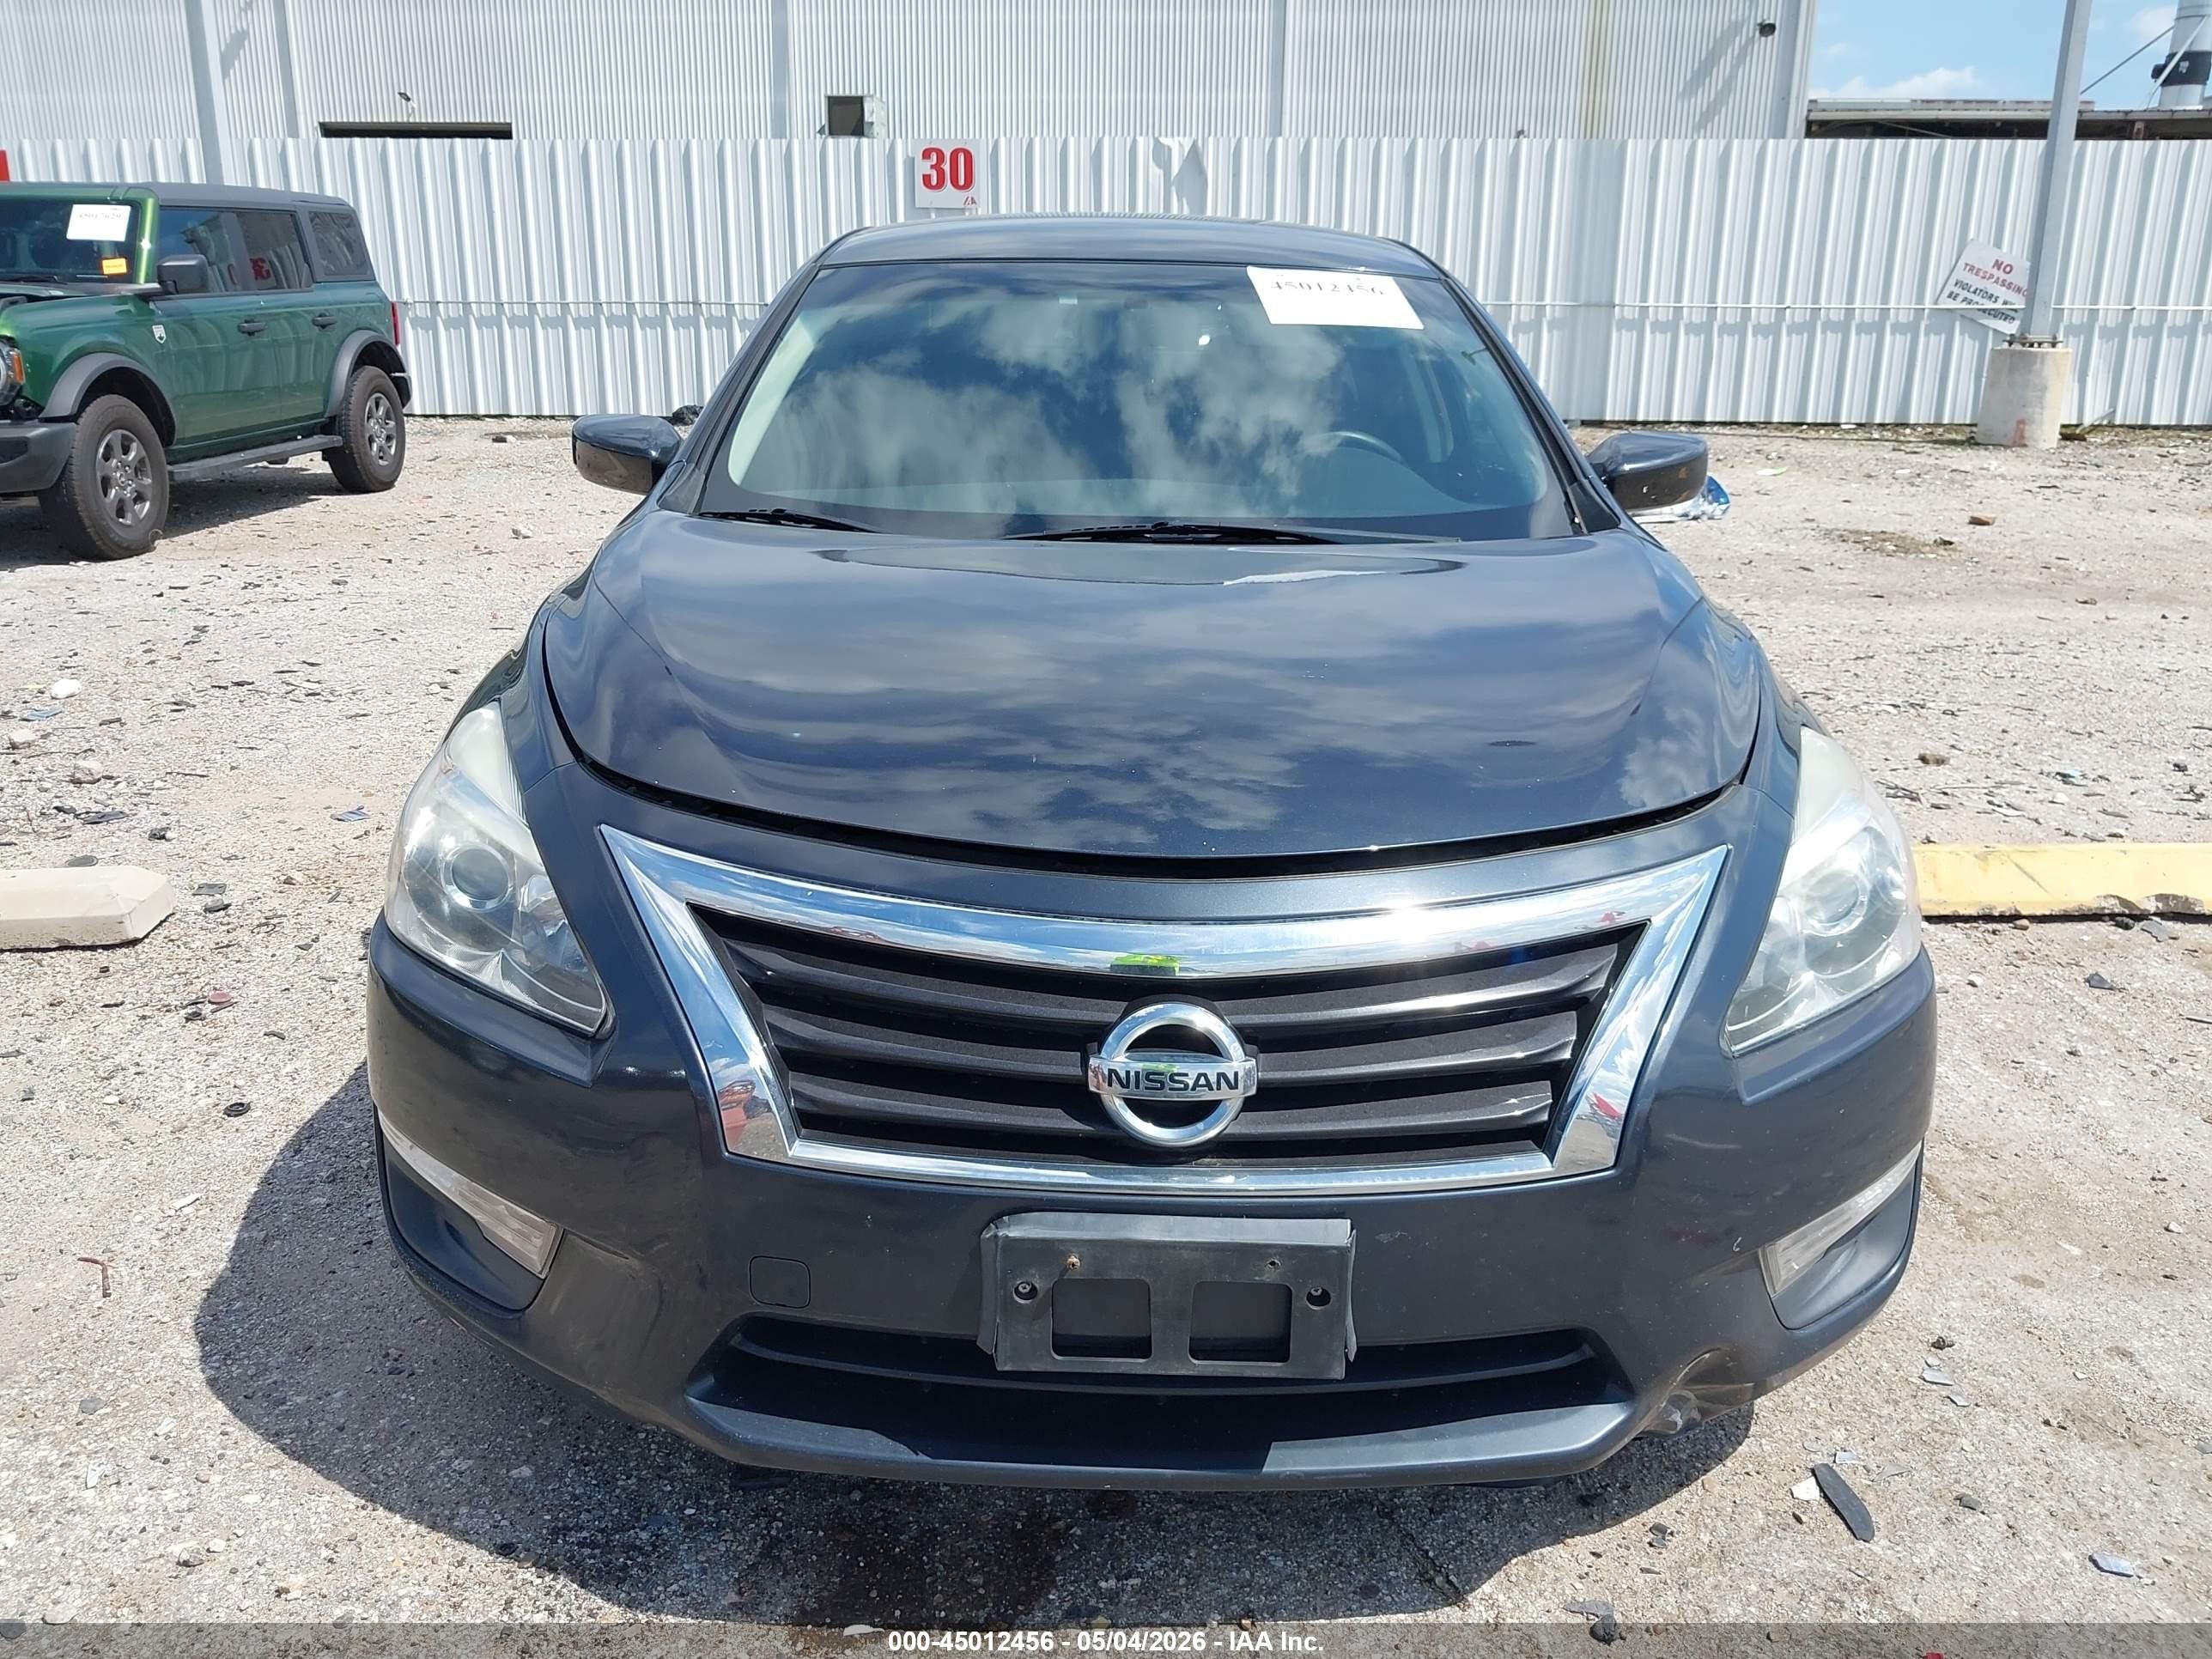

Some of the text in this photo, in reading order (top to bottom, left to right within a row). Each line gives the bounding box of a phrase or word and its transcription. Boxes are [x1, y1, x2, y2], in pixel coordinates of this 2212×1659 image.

[922, 147, 973, 191] 30
[1992, 258, 2014, 275] NO
[1947, 291, 1960, 301] BE
[1954, 279, 1999, 303] VIOLATORS
[1108, 1067, 1239, 1092] NISSAN
